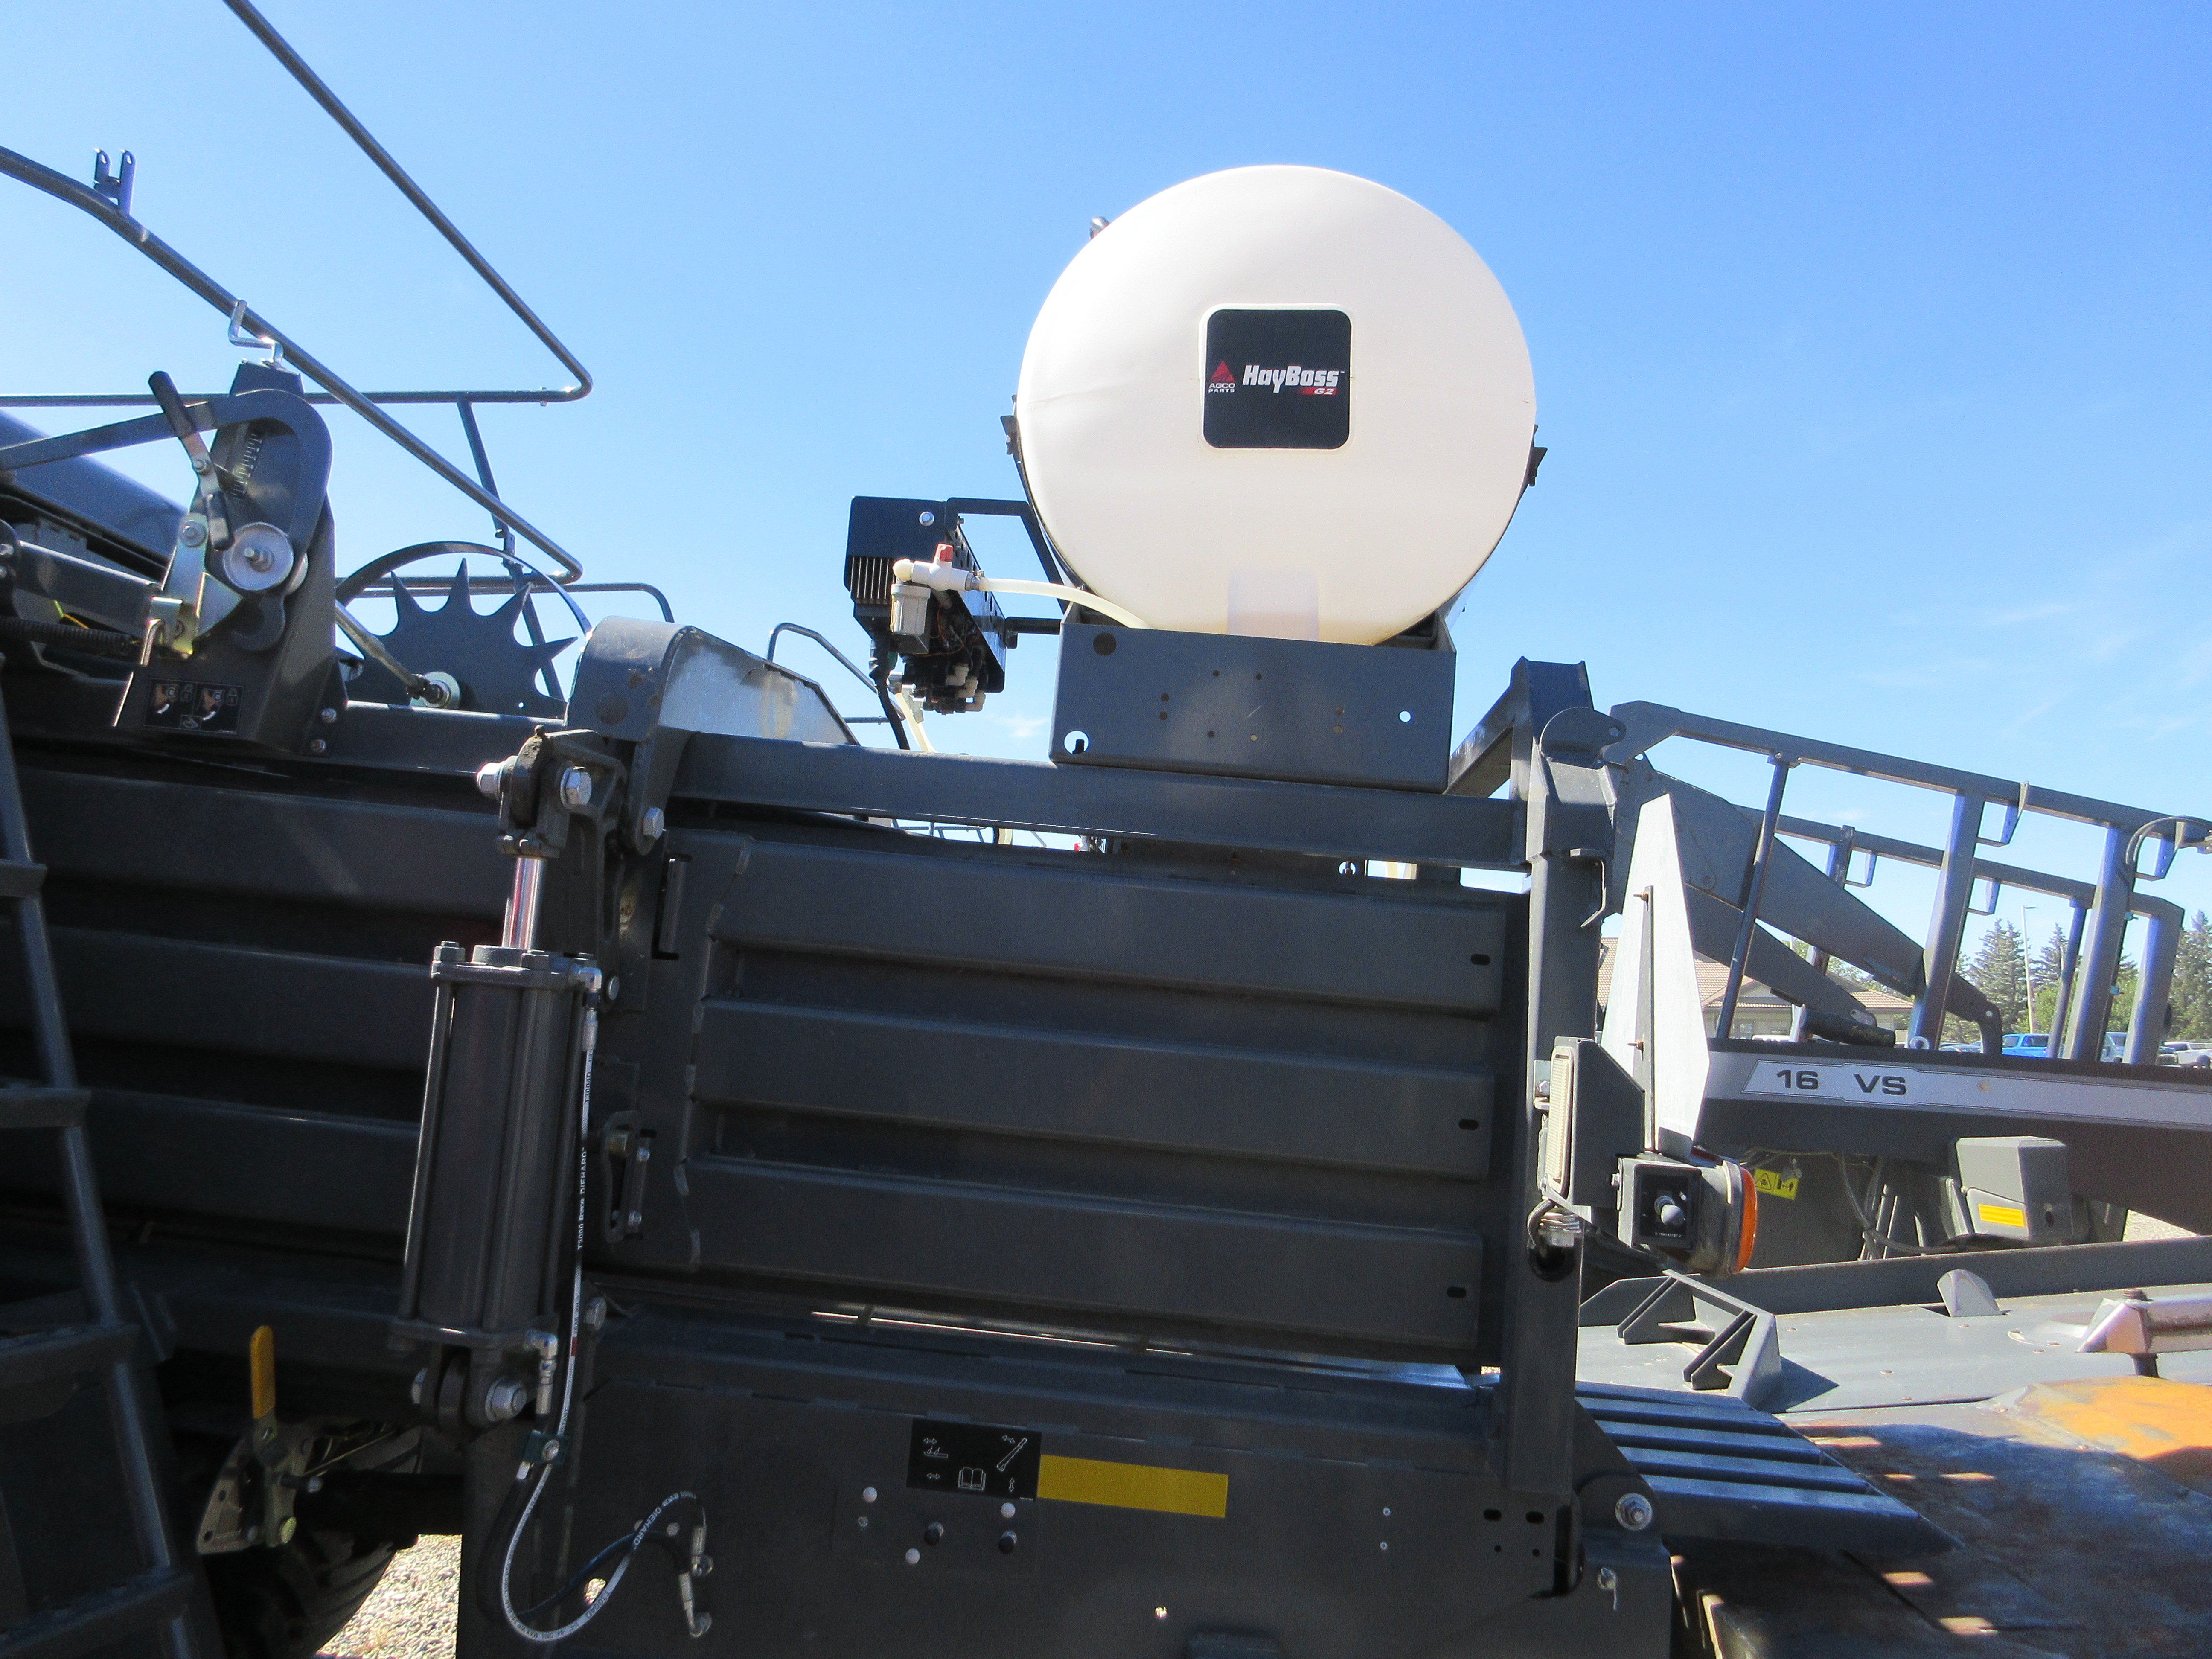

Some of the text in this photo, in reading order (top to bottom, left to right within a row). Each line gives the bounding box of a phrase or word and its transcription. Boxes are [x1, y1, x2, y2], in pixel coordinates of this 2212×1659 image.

[1243, 365, 1339, 394] HayBoss
[1776, 1069, 1907, 1096] 16 VS
[633, 1506, 662, 1546] DIEHARD
